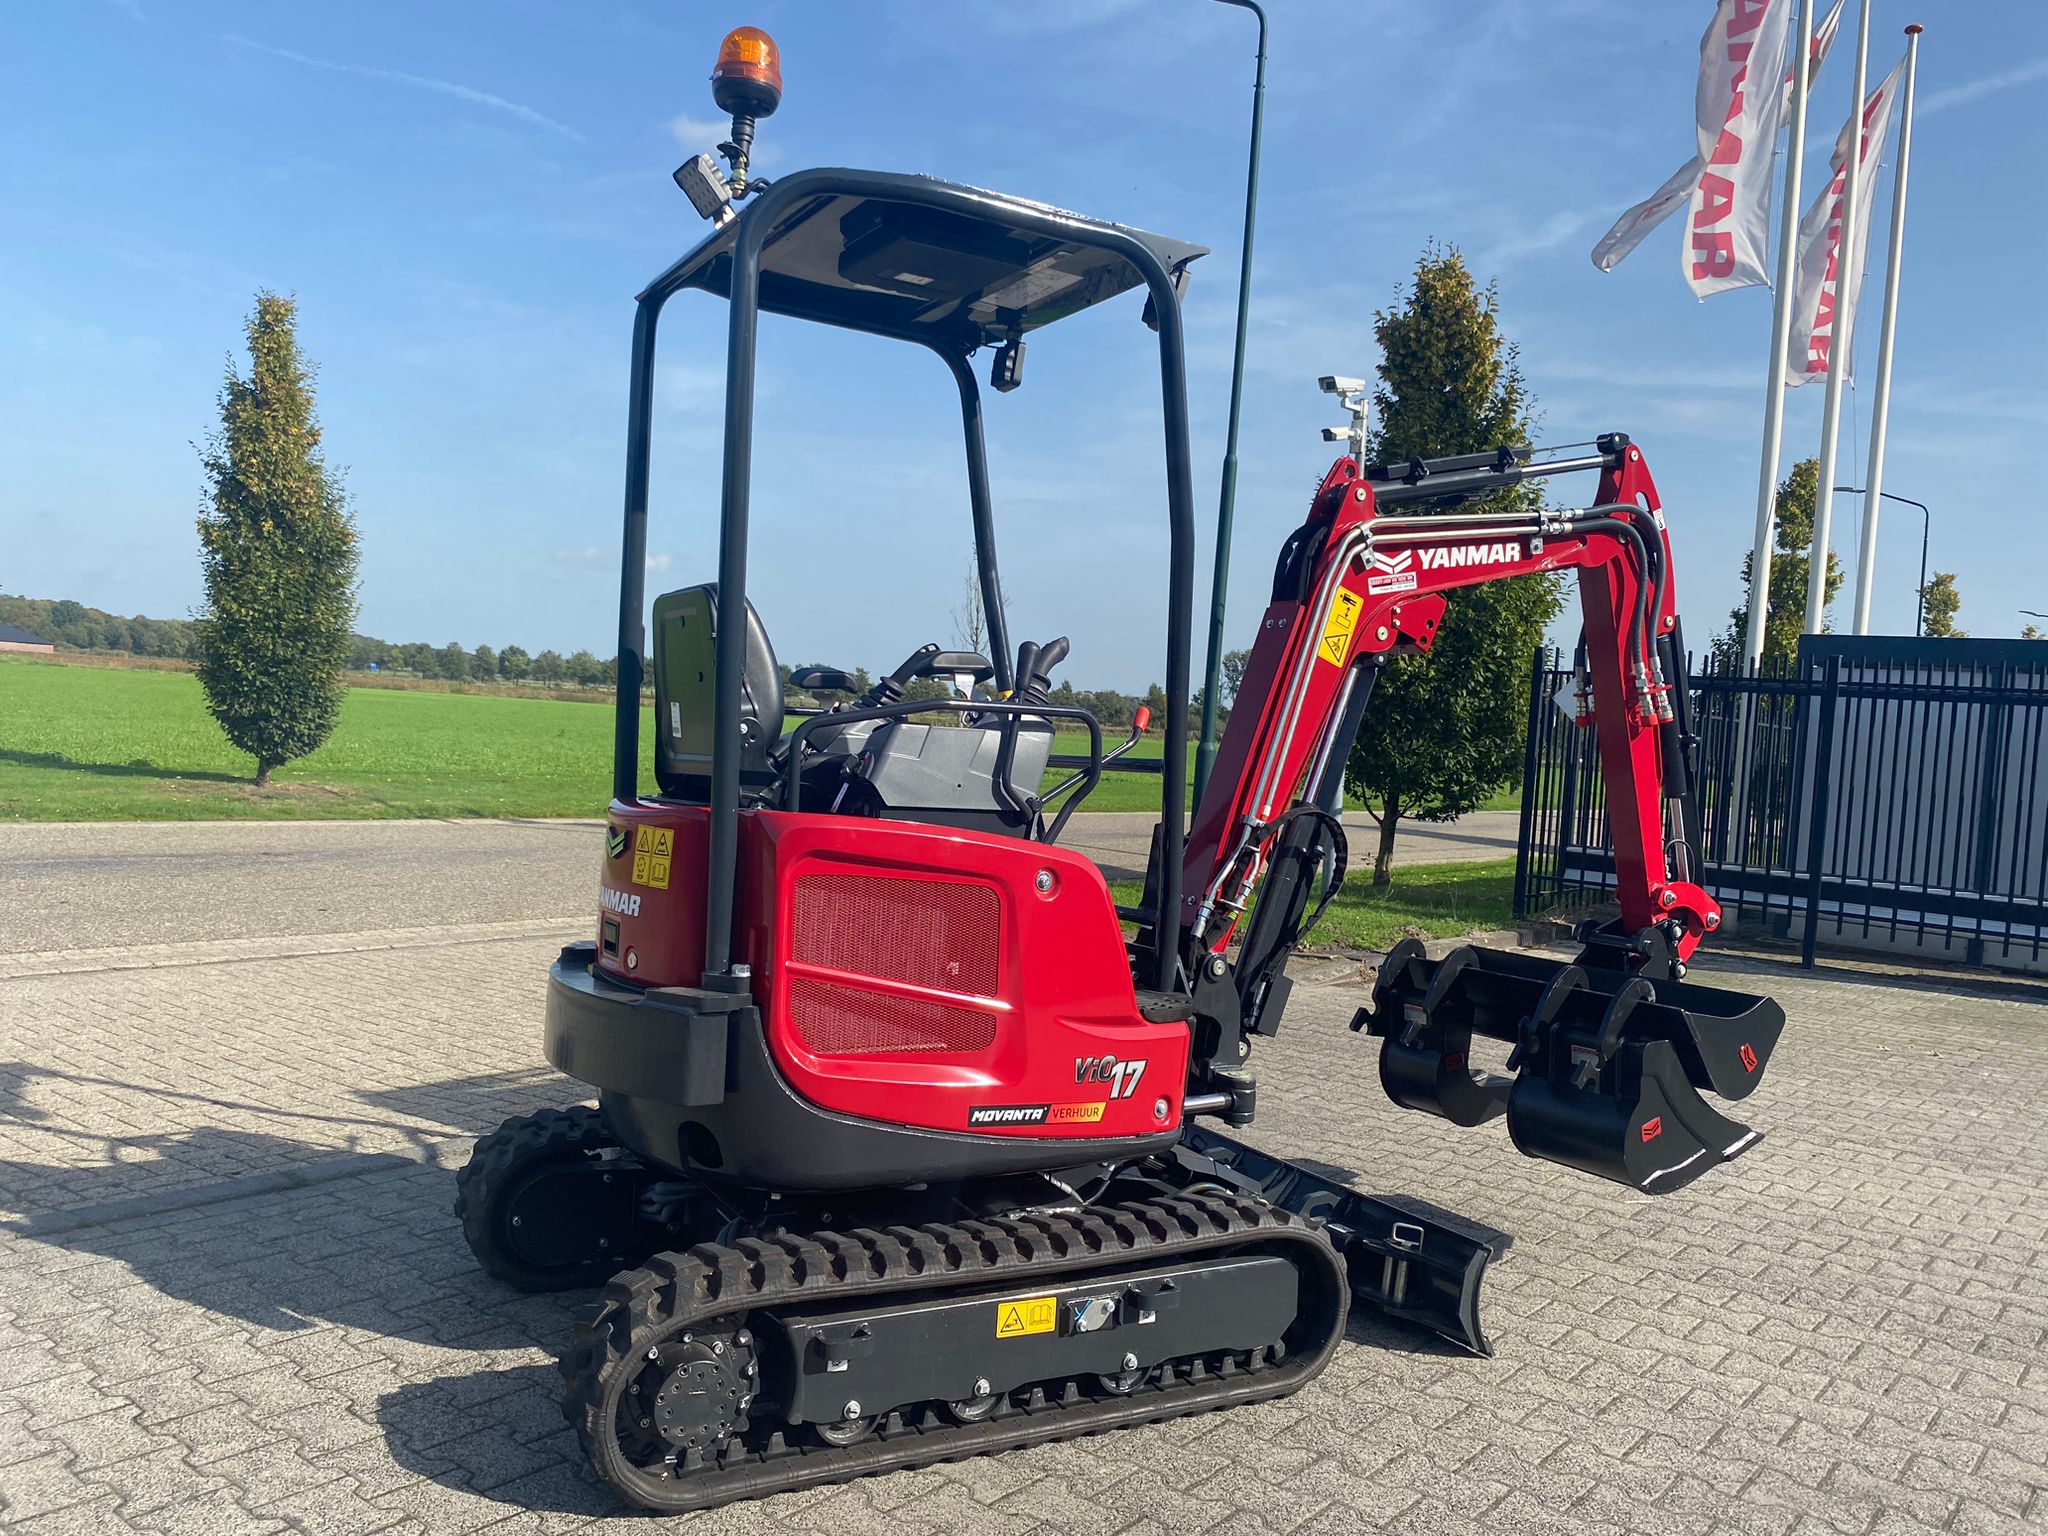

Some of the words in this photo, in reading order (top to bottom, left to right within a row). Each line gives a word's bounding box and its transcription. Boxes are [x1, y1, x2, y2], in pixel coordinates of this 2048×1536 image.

[1417, 542, 1521, 570] YANMAR
[970, 1108, 1045, 1122] MOVANTA
[1052, 1106, 1100, 1119] VERHUUR
